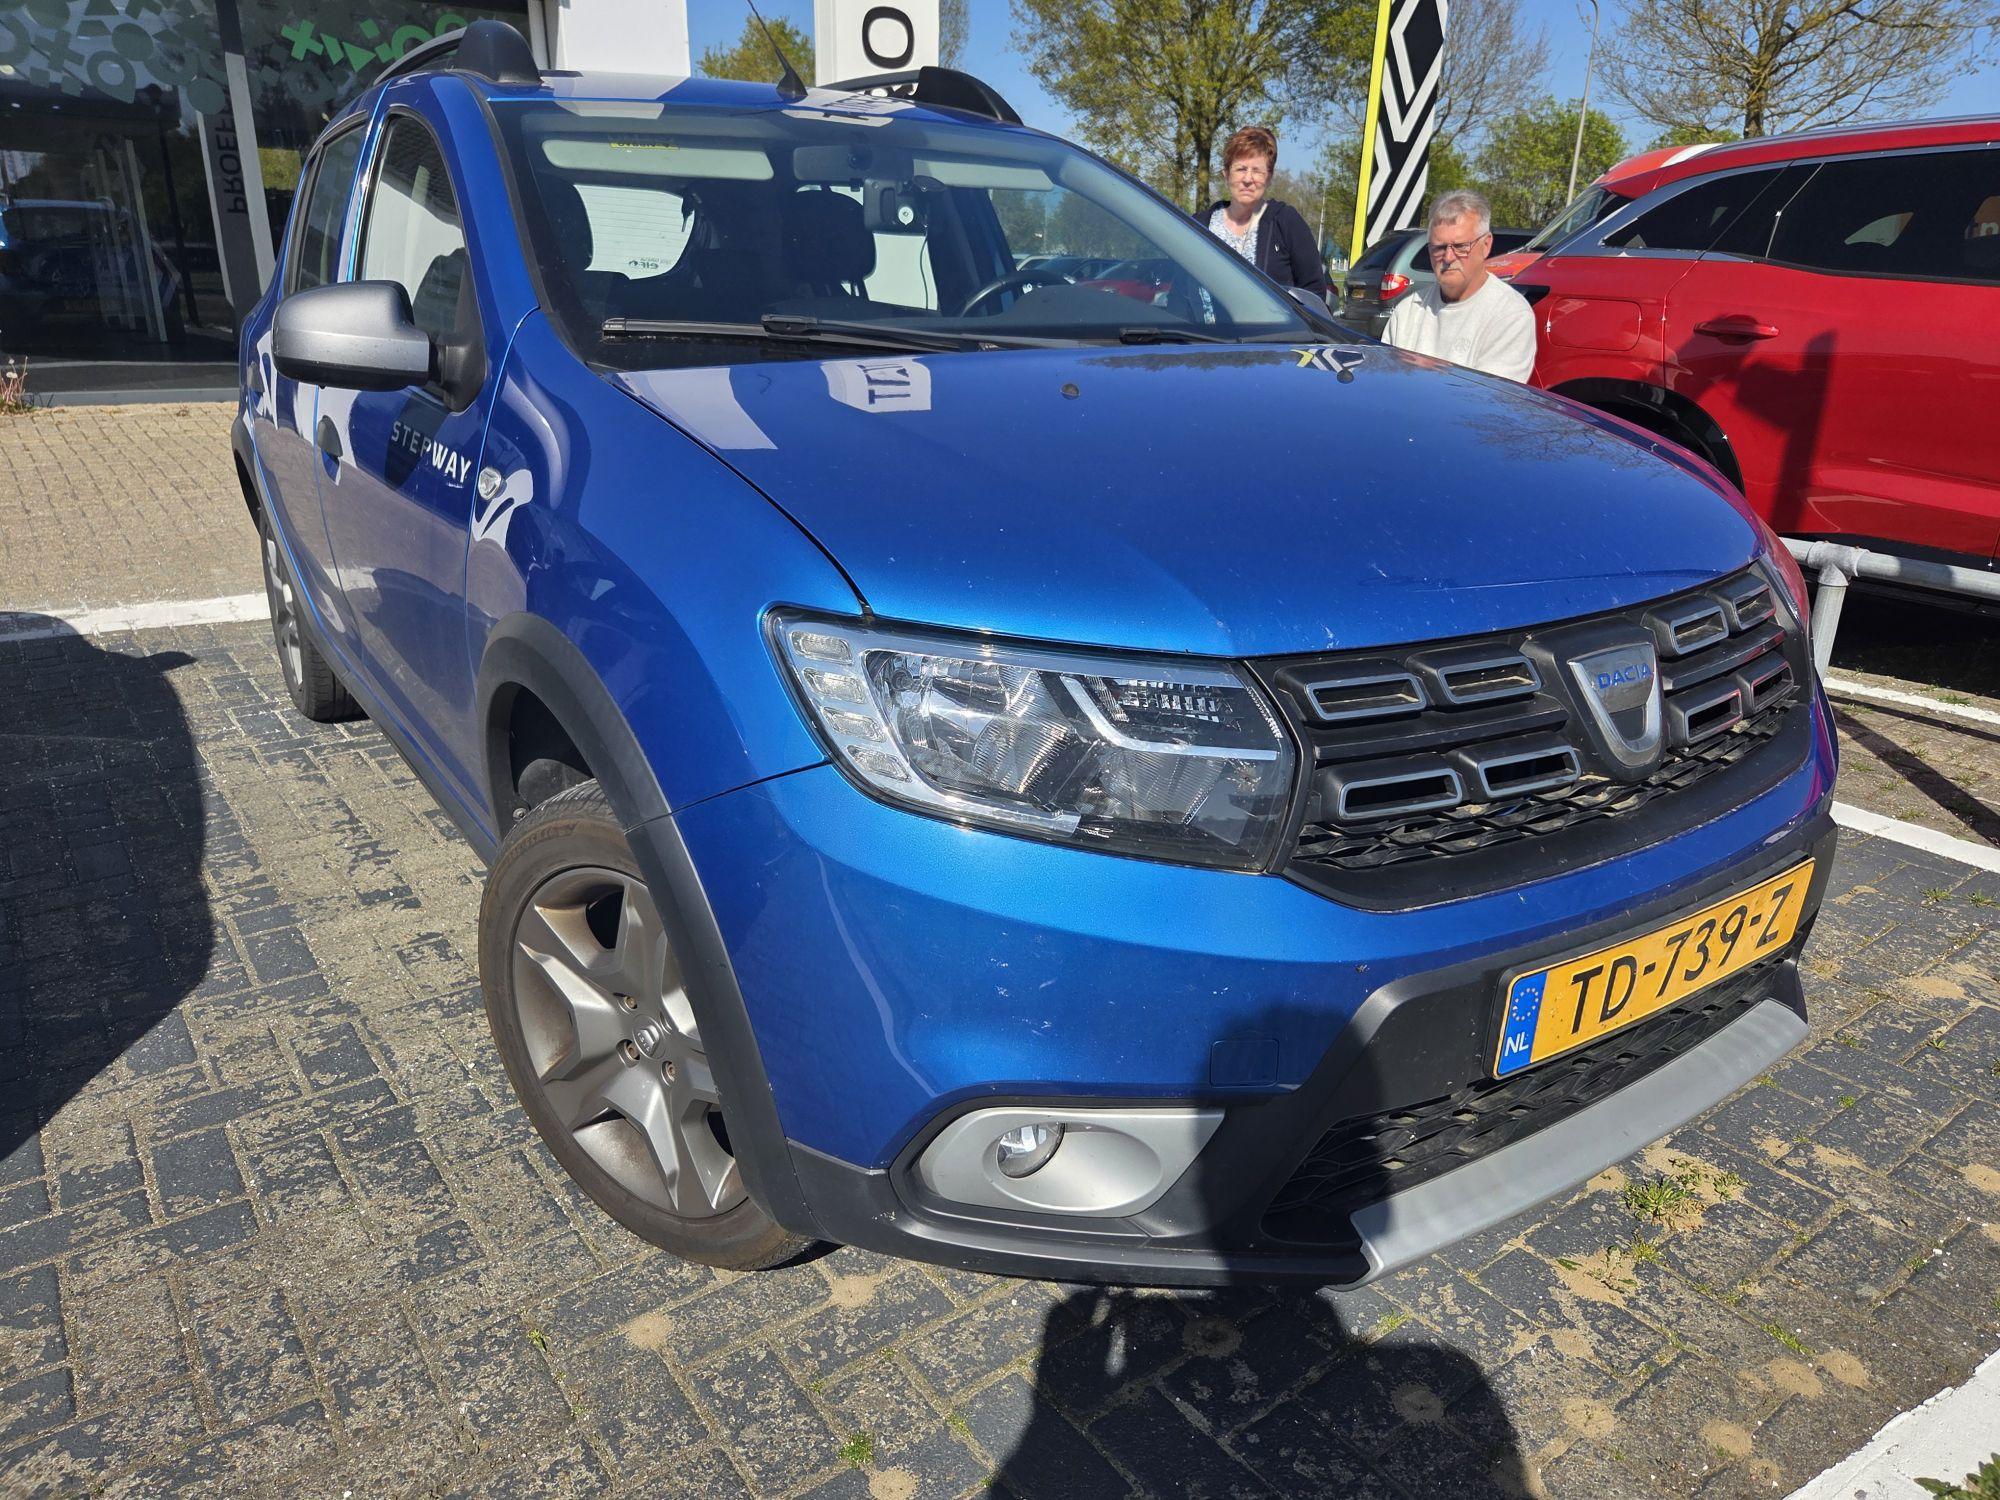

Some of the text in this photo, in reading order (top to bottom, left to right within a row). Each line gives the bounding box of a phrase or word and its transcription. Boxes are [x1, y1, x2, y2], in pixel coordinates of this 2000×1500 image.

[391, 421, 472, 484] STEPWAY
[1597, 662, 1652, 689] DACIA
[1571, 883, 1794, 1035] TD-739-Z
[1504, 1032, 1529, 1057] NL
